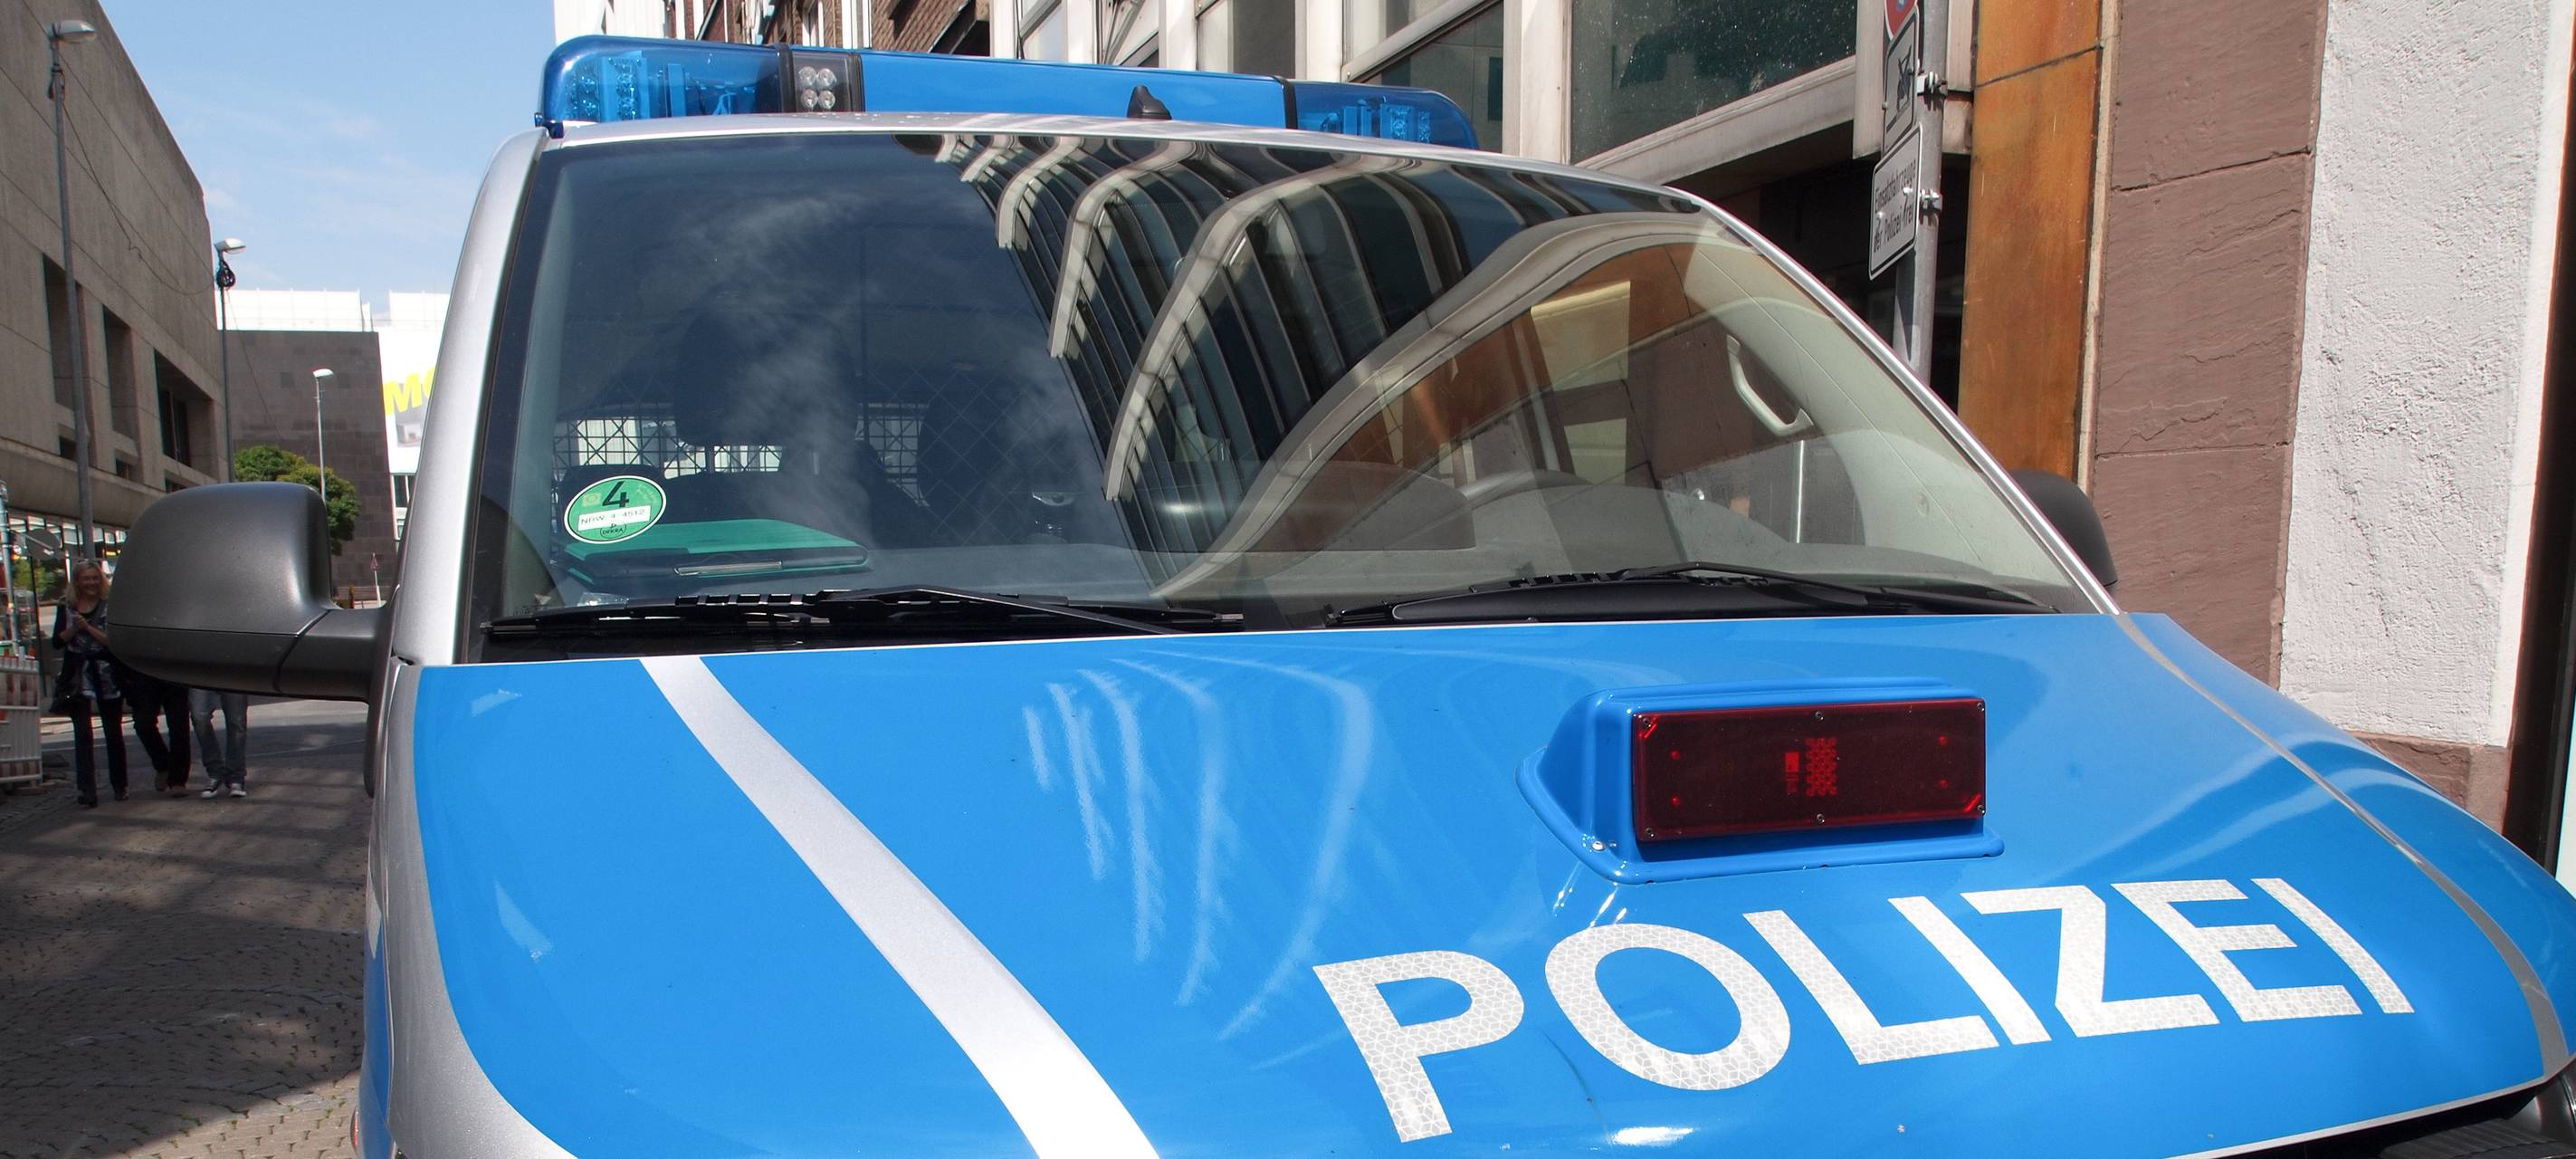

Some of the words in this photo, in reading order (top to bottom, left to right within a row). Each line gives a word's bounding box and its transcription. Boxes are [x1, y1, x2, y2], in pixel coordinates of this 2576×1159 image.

[1884, 206, 1902, 245] Polizei
[602, 481, 629, 507] 4
[1312, 876, 2413, 1142] POLIZEI
